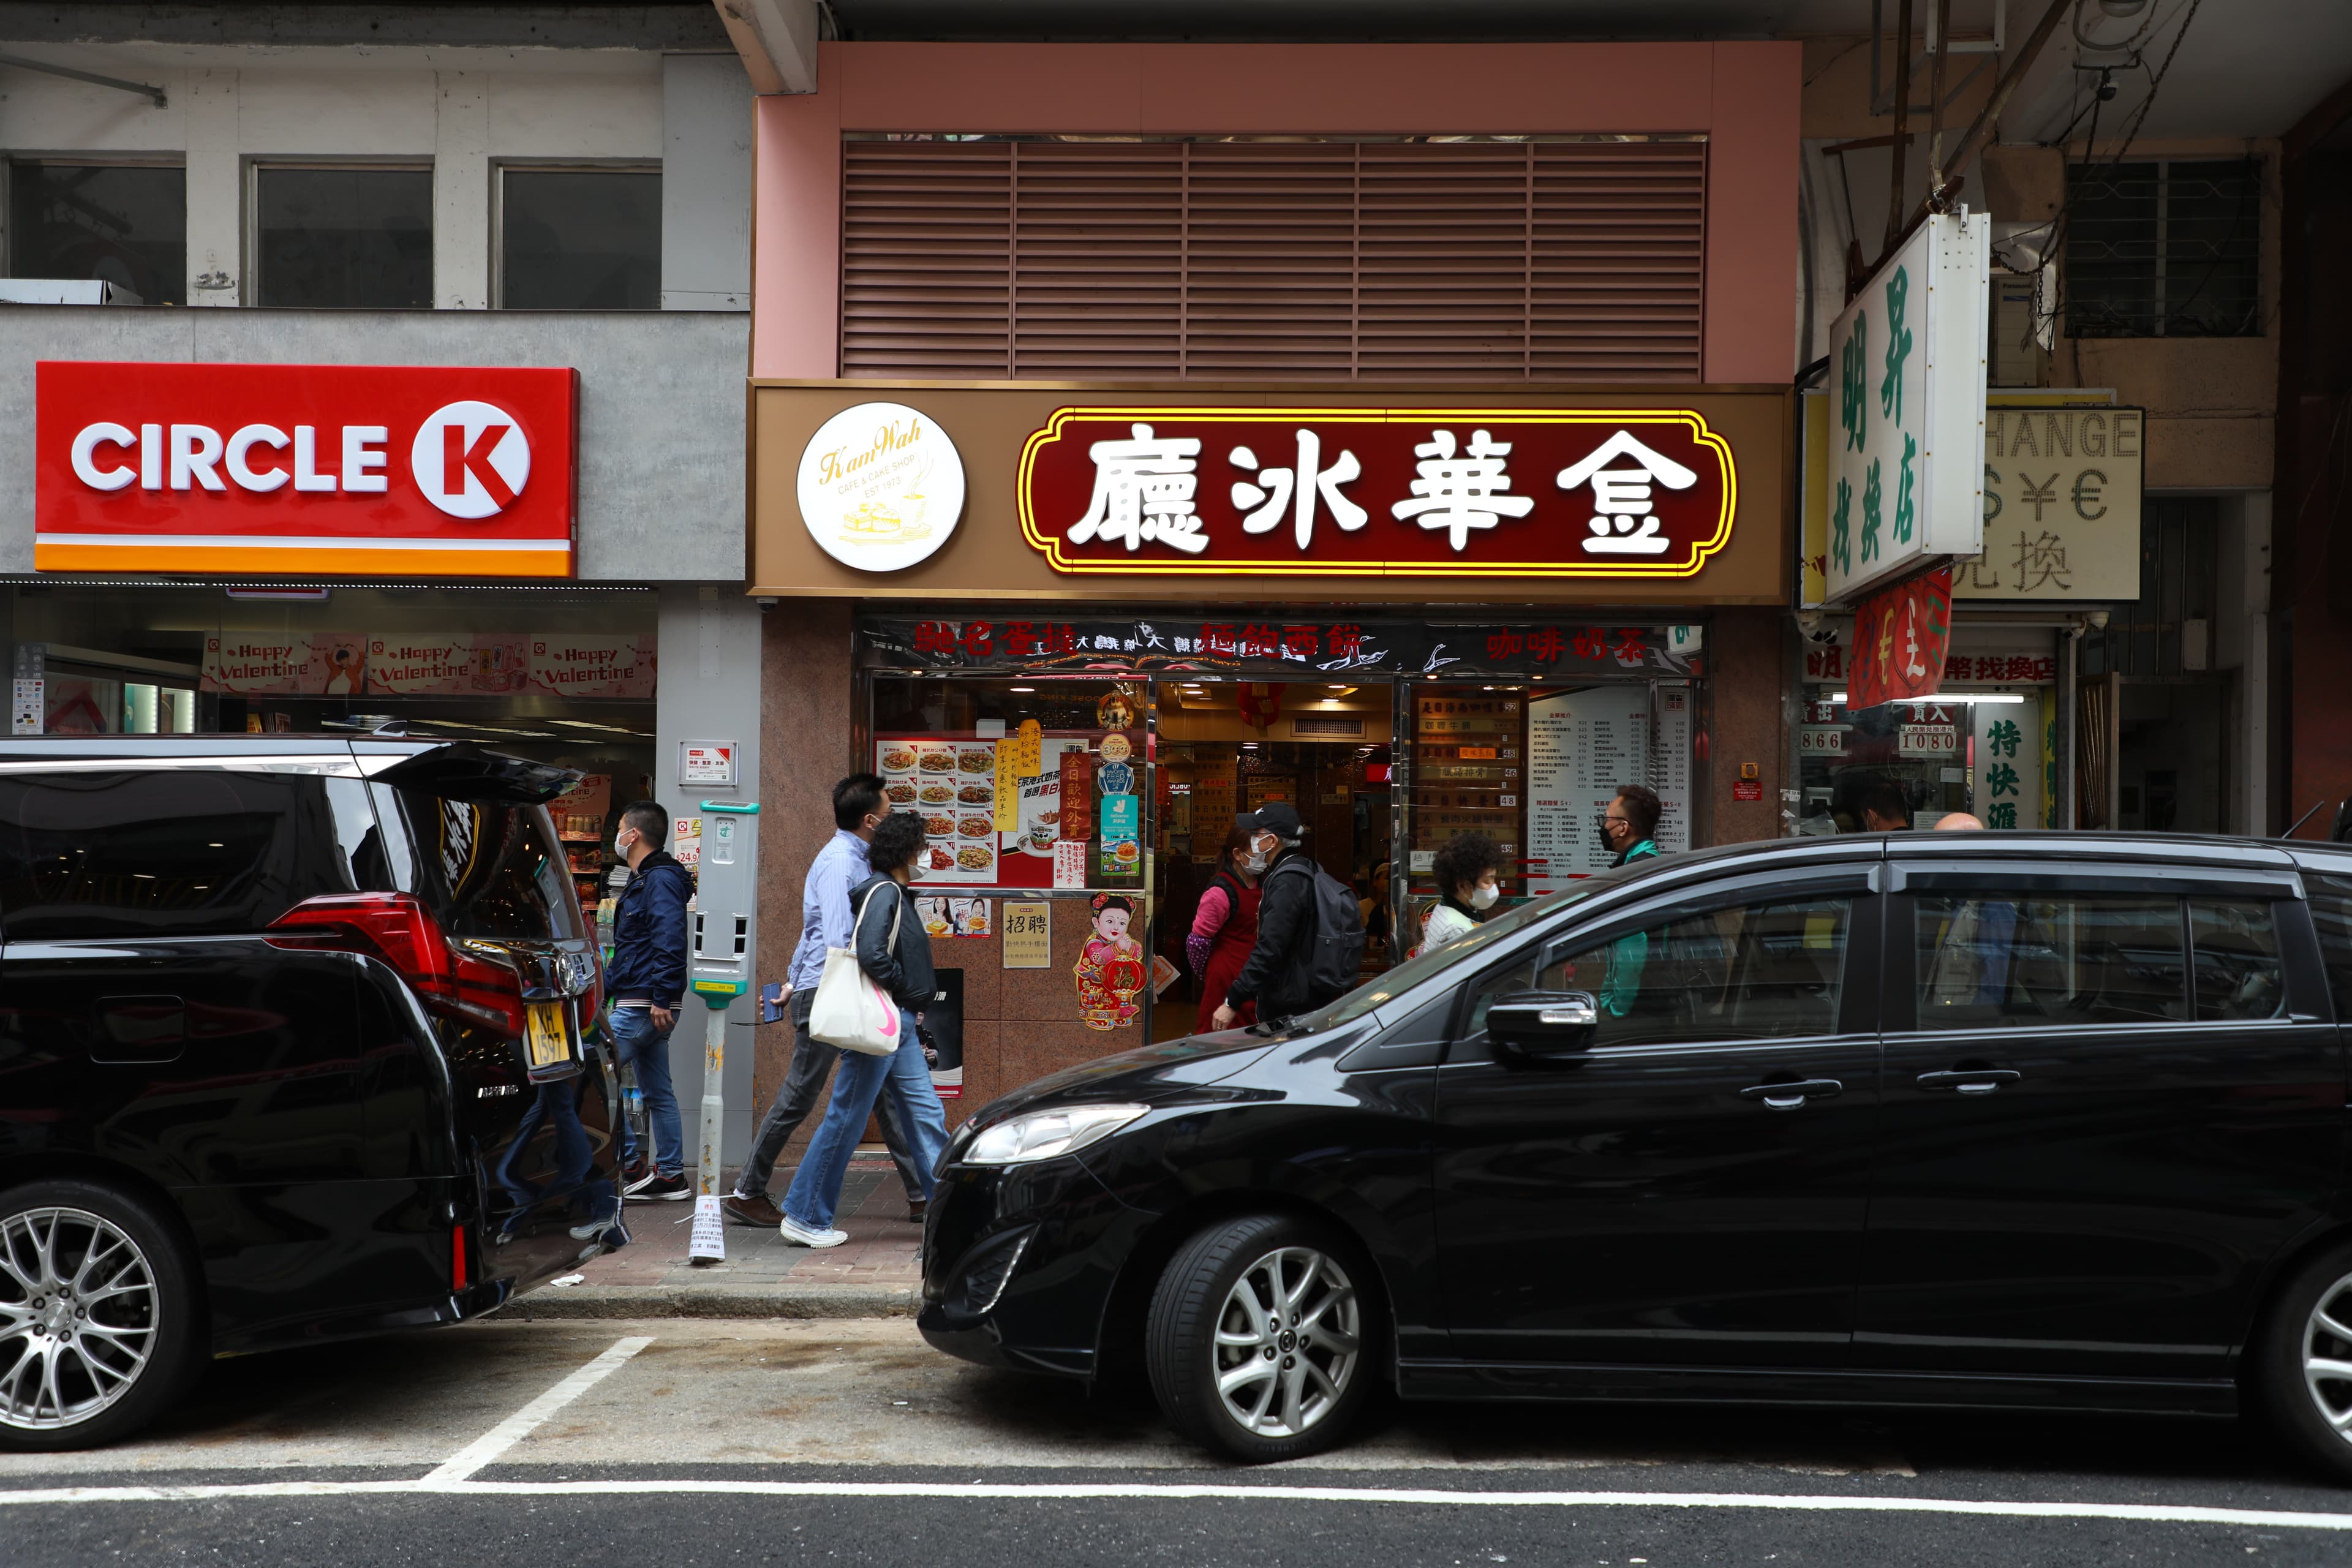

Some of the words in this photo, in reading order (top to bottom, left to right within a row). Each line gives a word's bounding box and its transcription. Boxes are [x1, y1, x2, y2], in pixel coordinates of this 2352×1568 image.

[71, 422, 388, 492] CIRCLE
[838, 480, 859, 495] CAFE
[868, 466, 891, 482] CAKE
[892, 454, 916, 471] SHOP
[865, 487, 880, 499] EST
[883, 477, 902, 491] 1973
[914, 620, 1078, 656] 馳名蛋撻
[1487, 625, 1648, 662] 咖啡奶茶
[239, 645, 293, 661] Happy
[400, 646, 452, 662] Happy
[565, 649, 618, 665] Happy
[219, 662, 308, 680] Valentine
[379, 662, 469, 683] Valentine
[545, 665, 634, 685] Valentine
[1913, 704, 1950, 722] 買入
[1903, 734, 1954, 749] 1080
[1023, 782, 1060, 799] 首選黑白
[1066, 755, 1082, 838] 全日歡迎外賣
[1006, 914, 1047, 934] 招聘
[1114, 964, 1136, 989] 福
[537, 1033, 561, 1062] 1597
